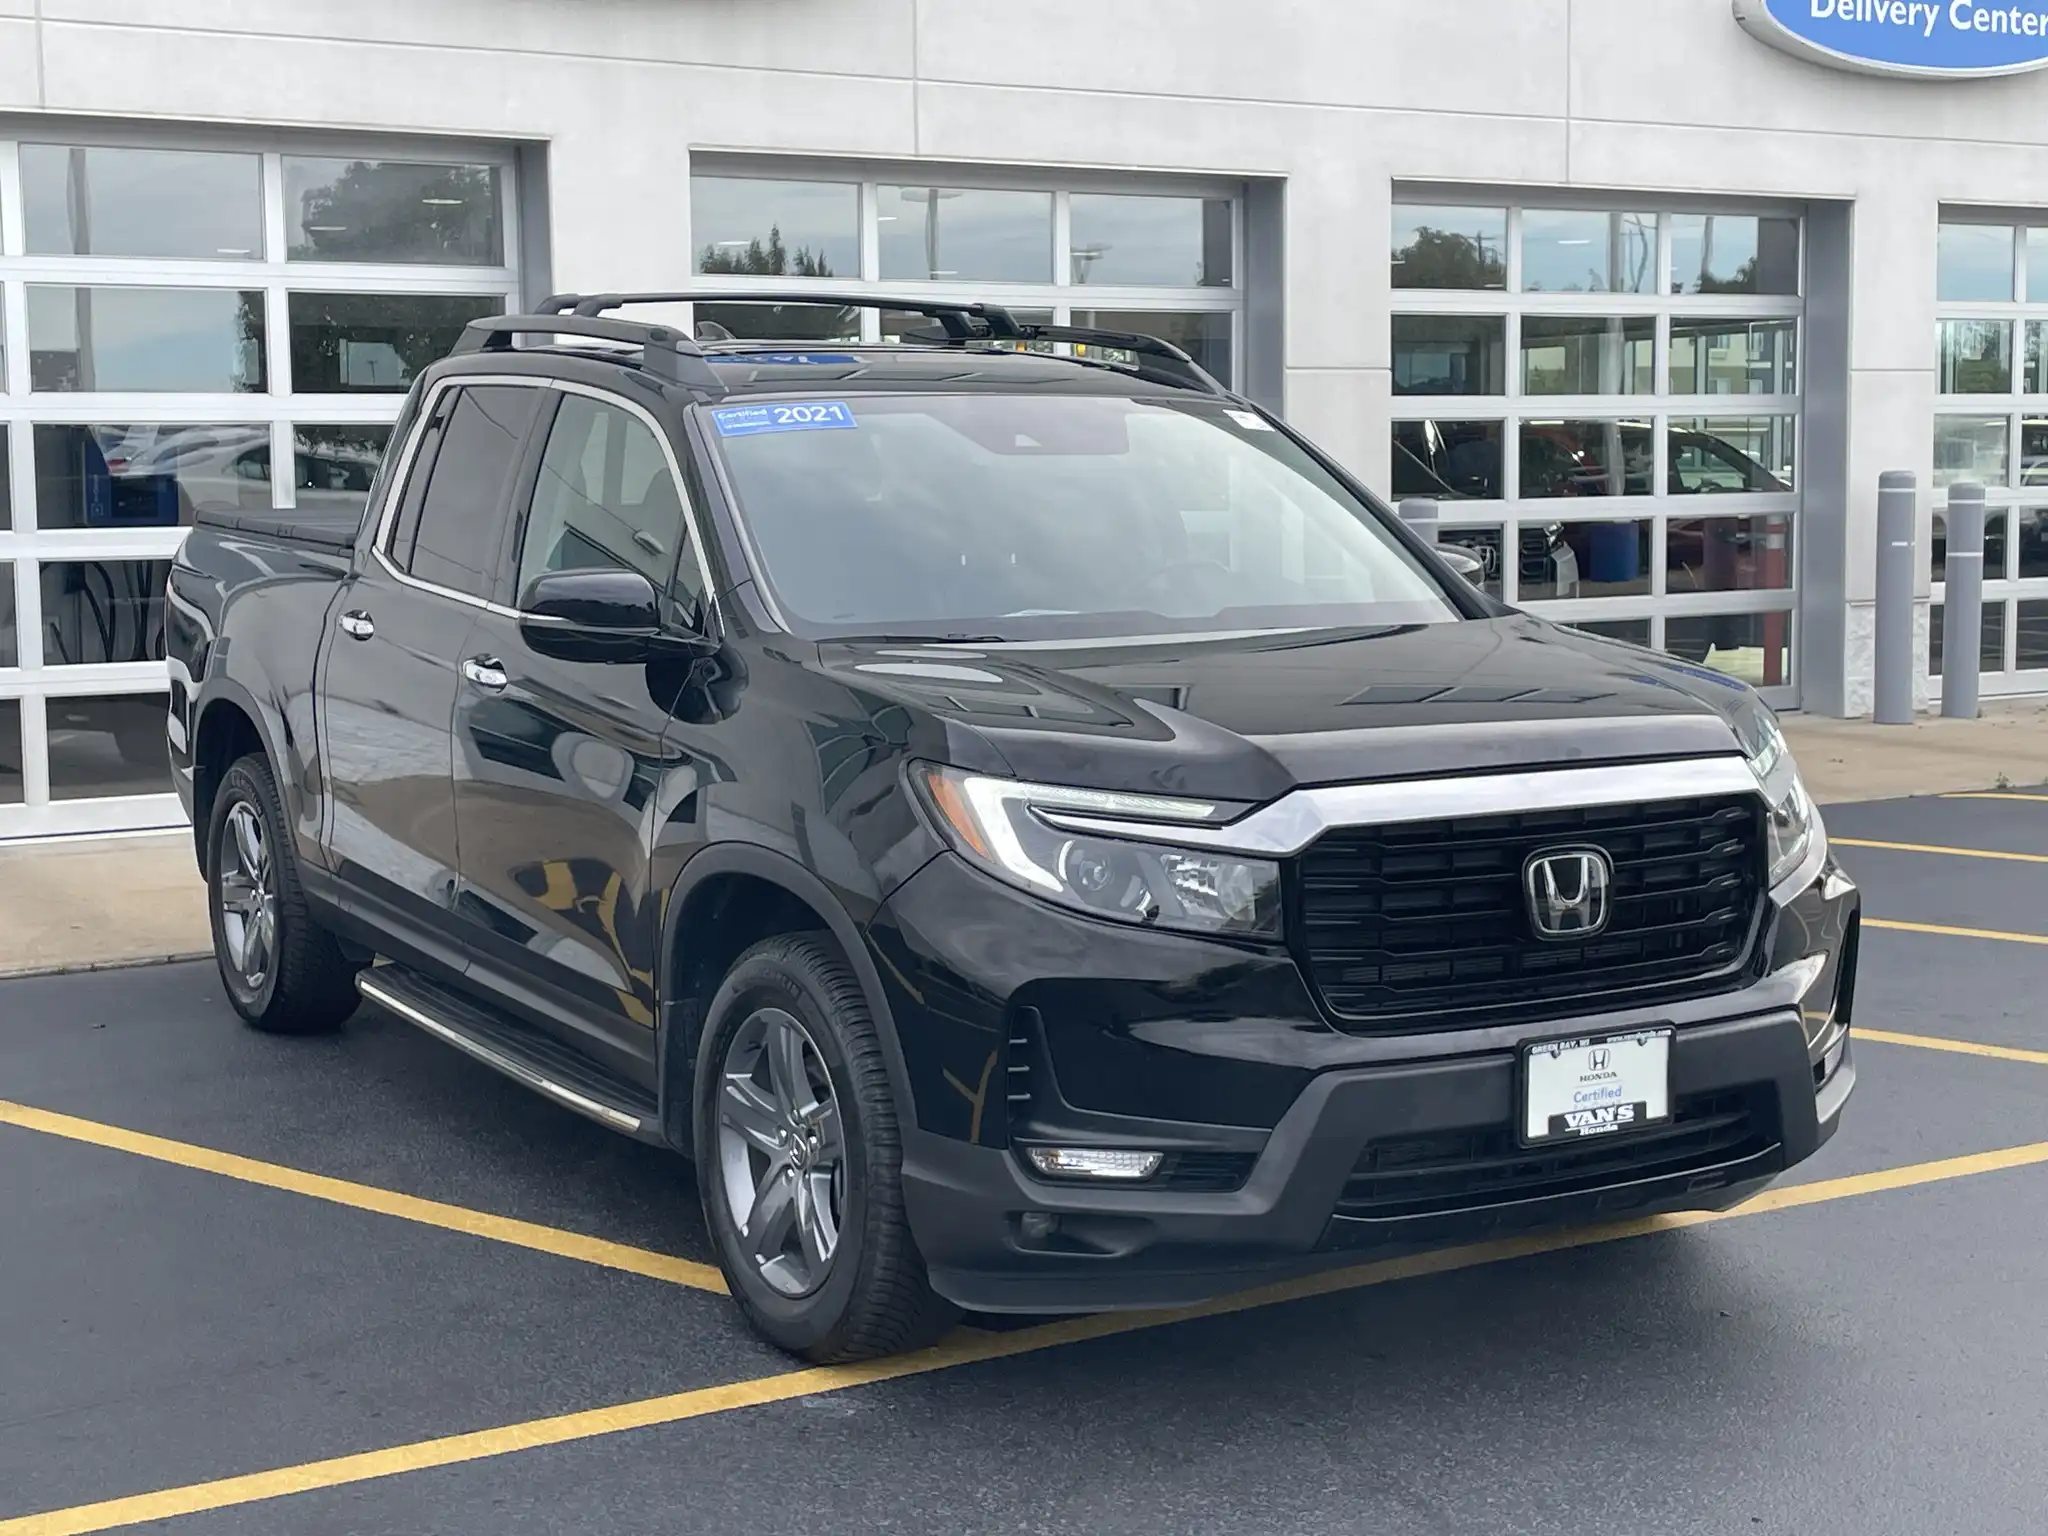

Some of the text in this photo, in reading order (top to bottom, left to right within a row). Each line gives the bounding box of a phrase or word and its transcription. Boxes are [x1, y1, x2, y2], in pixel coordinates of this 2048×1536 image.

[1811, 0, 2048, 37] Delivery Center
[774, 406, 845, 423] 2021
[1580, 1071, 1617, 1082] HONDA
[1573, 1085, 1622, 1103] Certified
[1579, 1122, 1618, 1136] Honda
